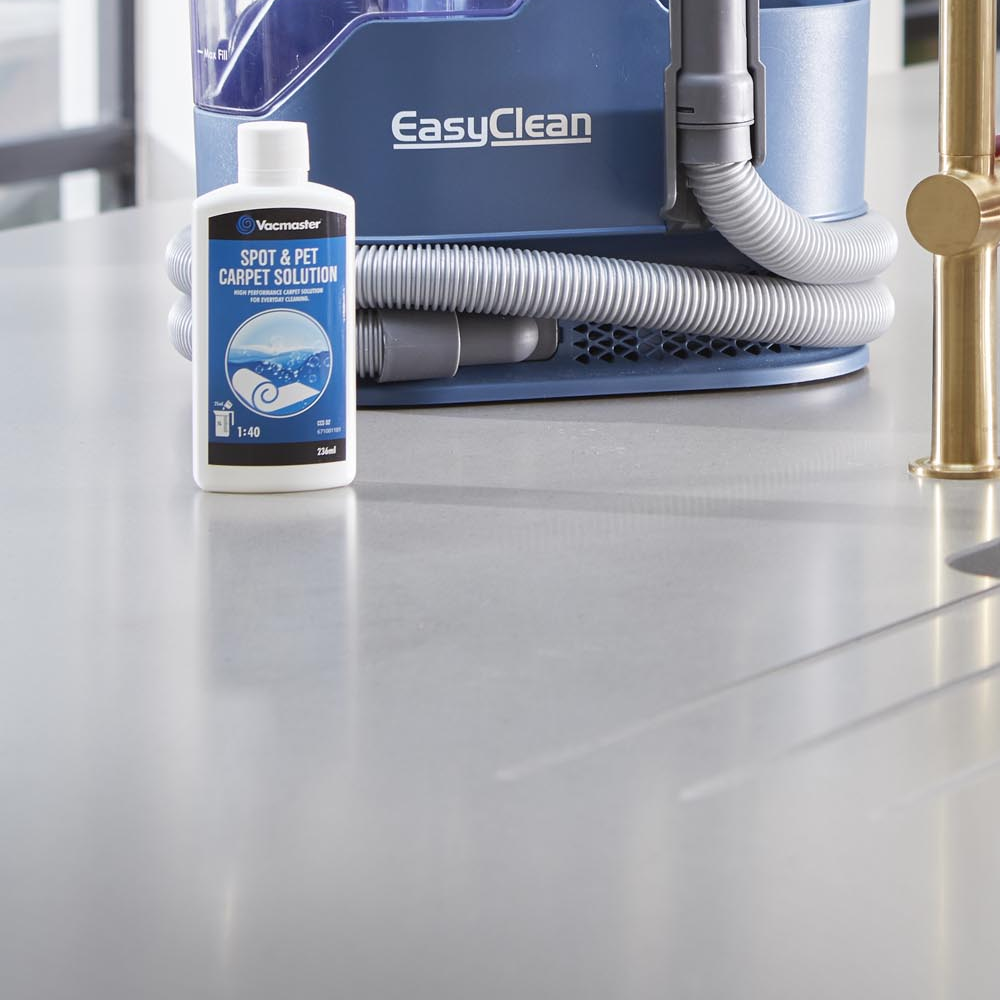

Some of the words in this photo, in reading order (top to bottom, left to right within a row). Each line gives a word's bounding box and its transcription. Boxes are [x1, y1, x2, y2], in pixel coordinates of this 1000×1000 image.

[217, 49, 228, 60] Fill
[391, 107, 592, 149] EasyClean
[256, 219, 321, 231] Vacmaster
[240, 249, 276, 266] SPOT
[280, 249, 291, 266] &
[294, 247, 319, 265] PET
[219, 268, 271, 285] CARPET
[274, 266, 337, 285] SOLUTION
[247, 288, 282, 296] PERFORMANCE
[283, 287, 301, 295] CARPET
[237, 426, 260, 438] 1:40
[316, 445, 337, 456] 236ml
